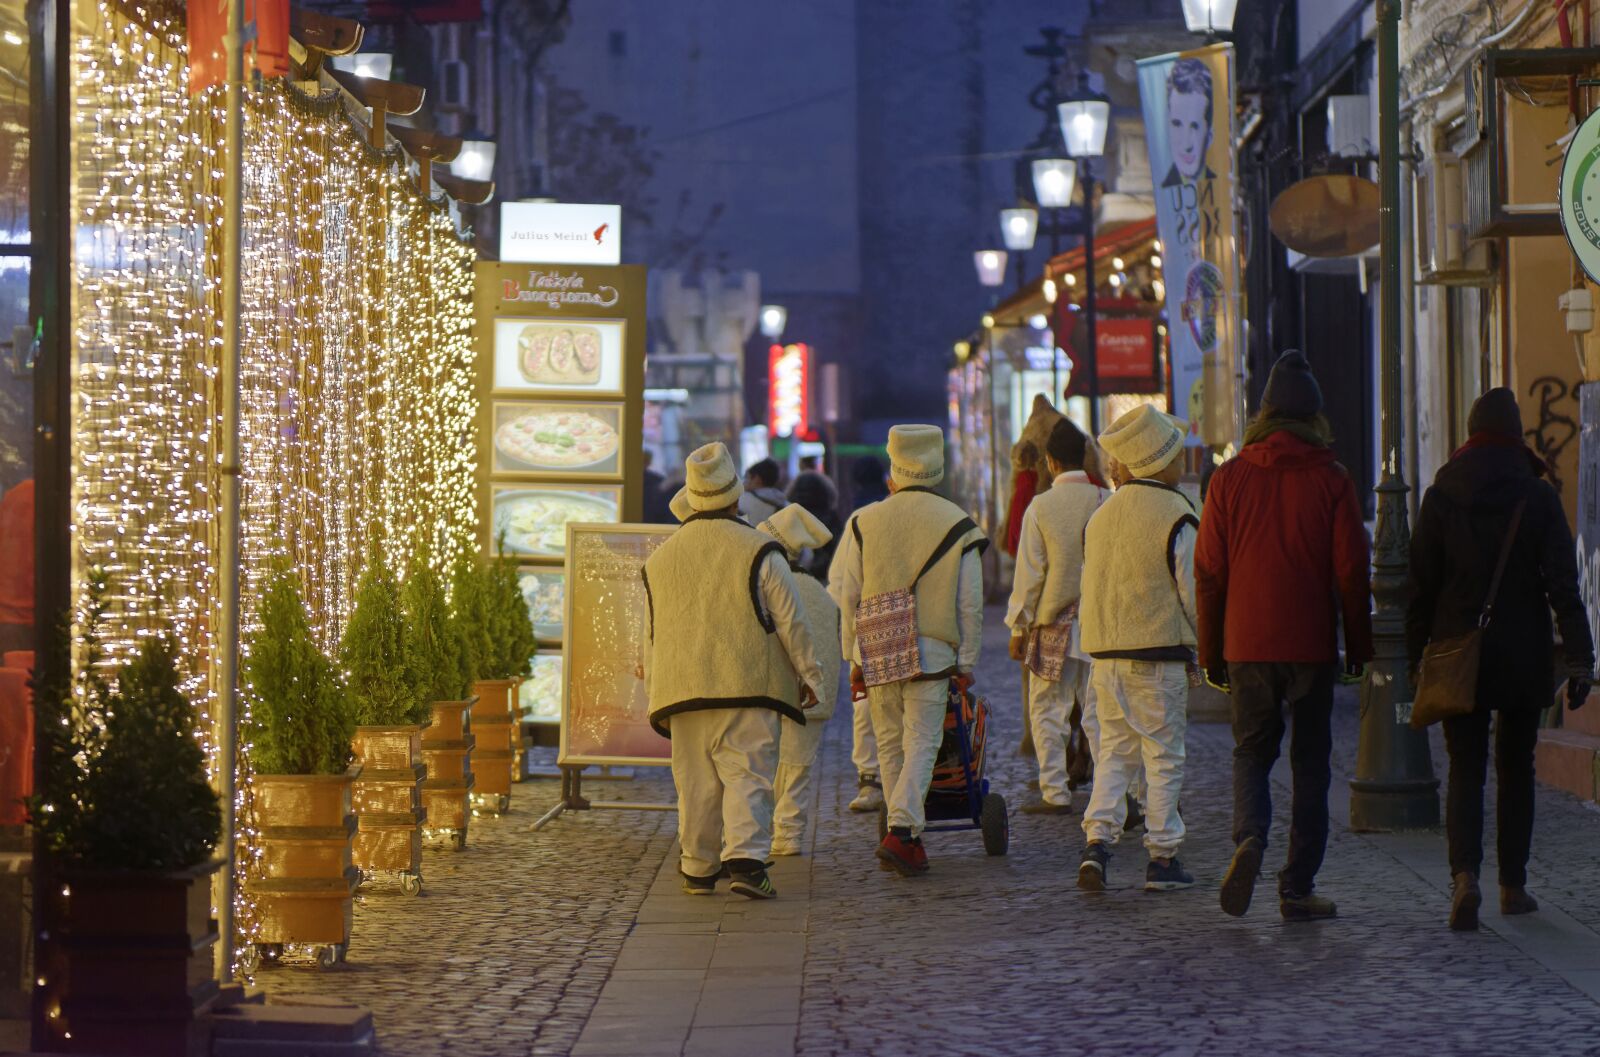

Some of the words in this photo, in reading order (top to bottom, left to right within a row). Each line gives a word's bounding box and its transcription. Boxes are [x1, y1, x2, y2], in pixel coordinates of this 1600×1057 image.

[1574, 201, 1596, 240] SHOP
[511, 231, 550, 240] Julius
[554, 231, 588, 241] Meinl
